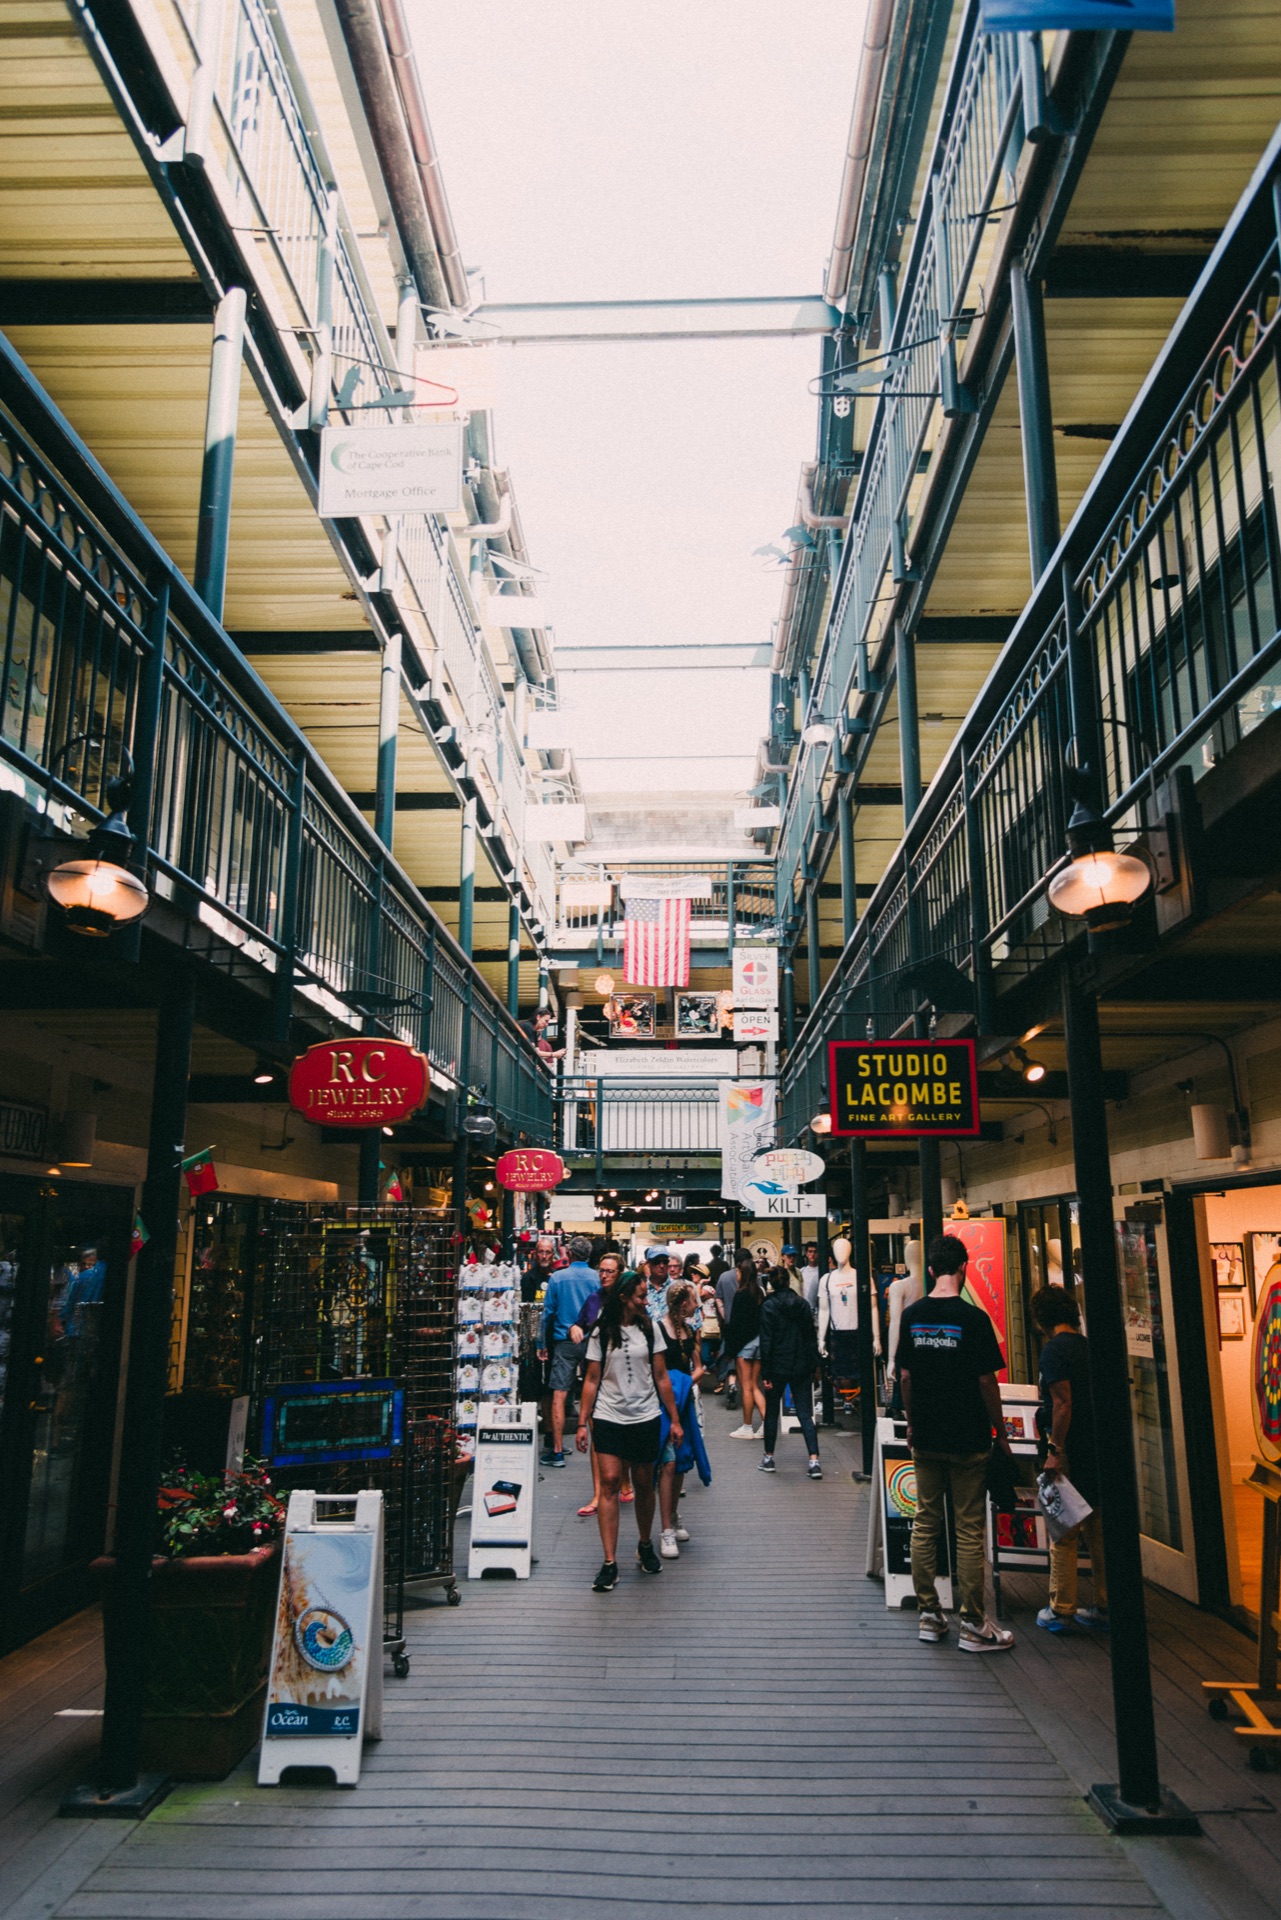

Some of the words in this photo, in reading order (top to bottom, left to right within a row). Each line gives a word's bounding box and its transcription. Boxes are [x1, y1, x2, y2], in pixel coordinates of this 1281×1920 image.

[348, 450, 366, 460] The
[368, 450, 426, 462] Cooperative
[428, 448, 453, 458] Bank
[347, 461, 358, 471] of
[358, 461, 383, 472] Cape
[384, 461, 404, 470] Cod
[344, 488, 398, 500] Mortgage
[402, 486, 437, 498] Office
[739, 951, 771, 961] SILVER
[740, 986, 771, 995] GLASS
[741, 1016, 771, 1024] OPEN
[328, 1049, 387, 1084] RC
[857, 1053, 947, 1077] STUDIO
[307, 1087, 408, 1108] JEWELRY
[846, 1082, 962, 1106] LACOMBE
[848, 1114, 876, 1122] FINE
[879, 1113, 904, 1121] ART
[907, 1112, 962, 1121] GALLERY
[515, 1154, 544, 1172] RC
[505, 1172, 555, 1183] JEWELRY
[665, 1196, 683, 1210] EXIT
[913, 1337, 958, 1348] patagonia
[482, 1432, 492, 1441] The
[491, 1432, 530, 1442] AUTHENTIC
[271, 1712, 309, 1726] Ocean
